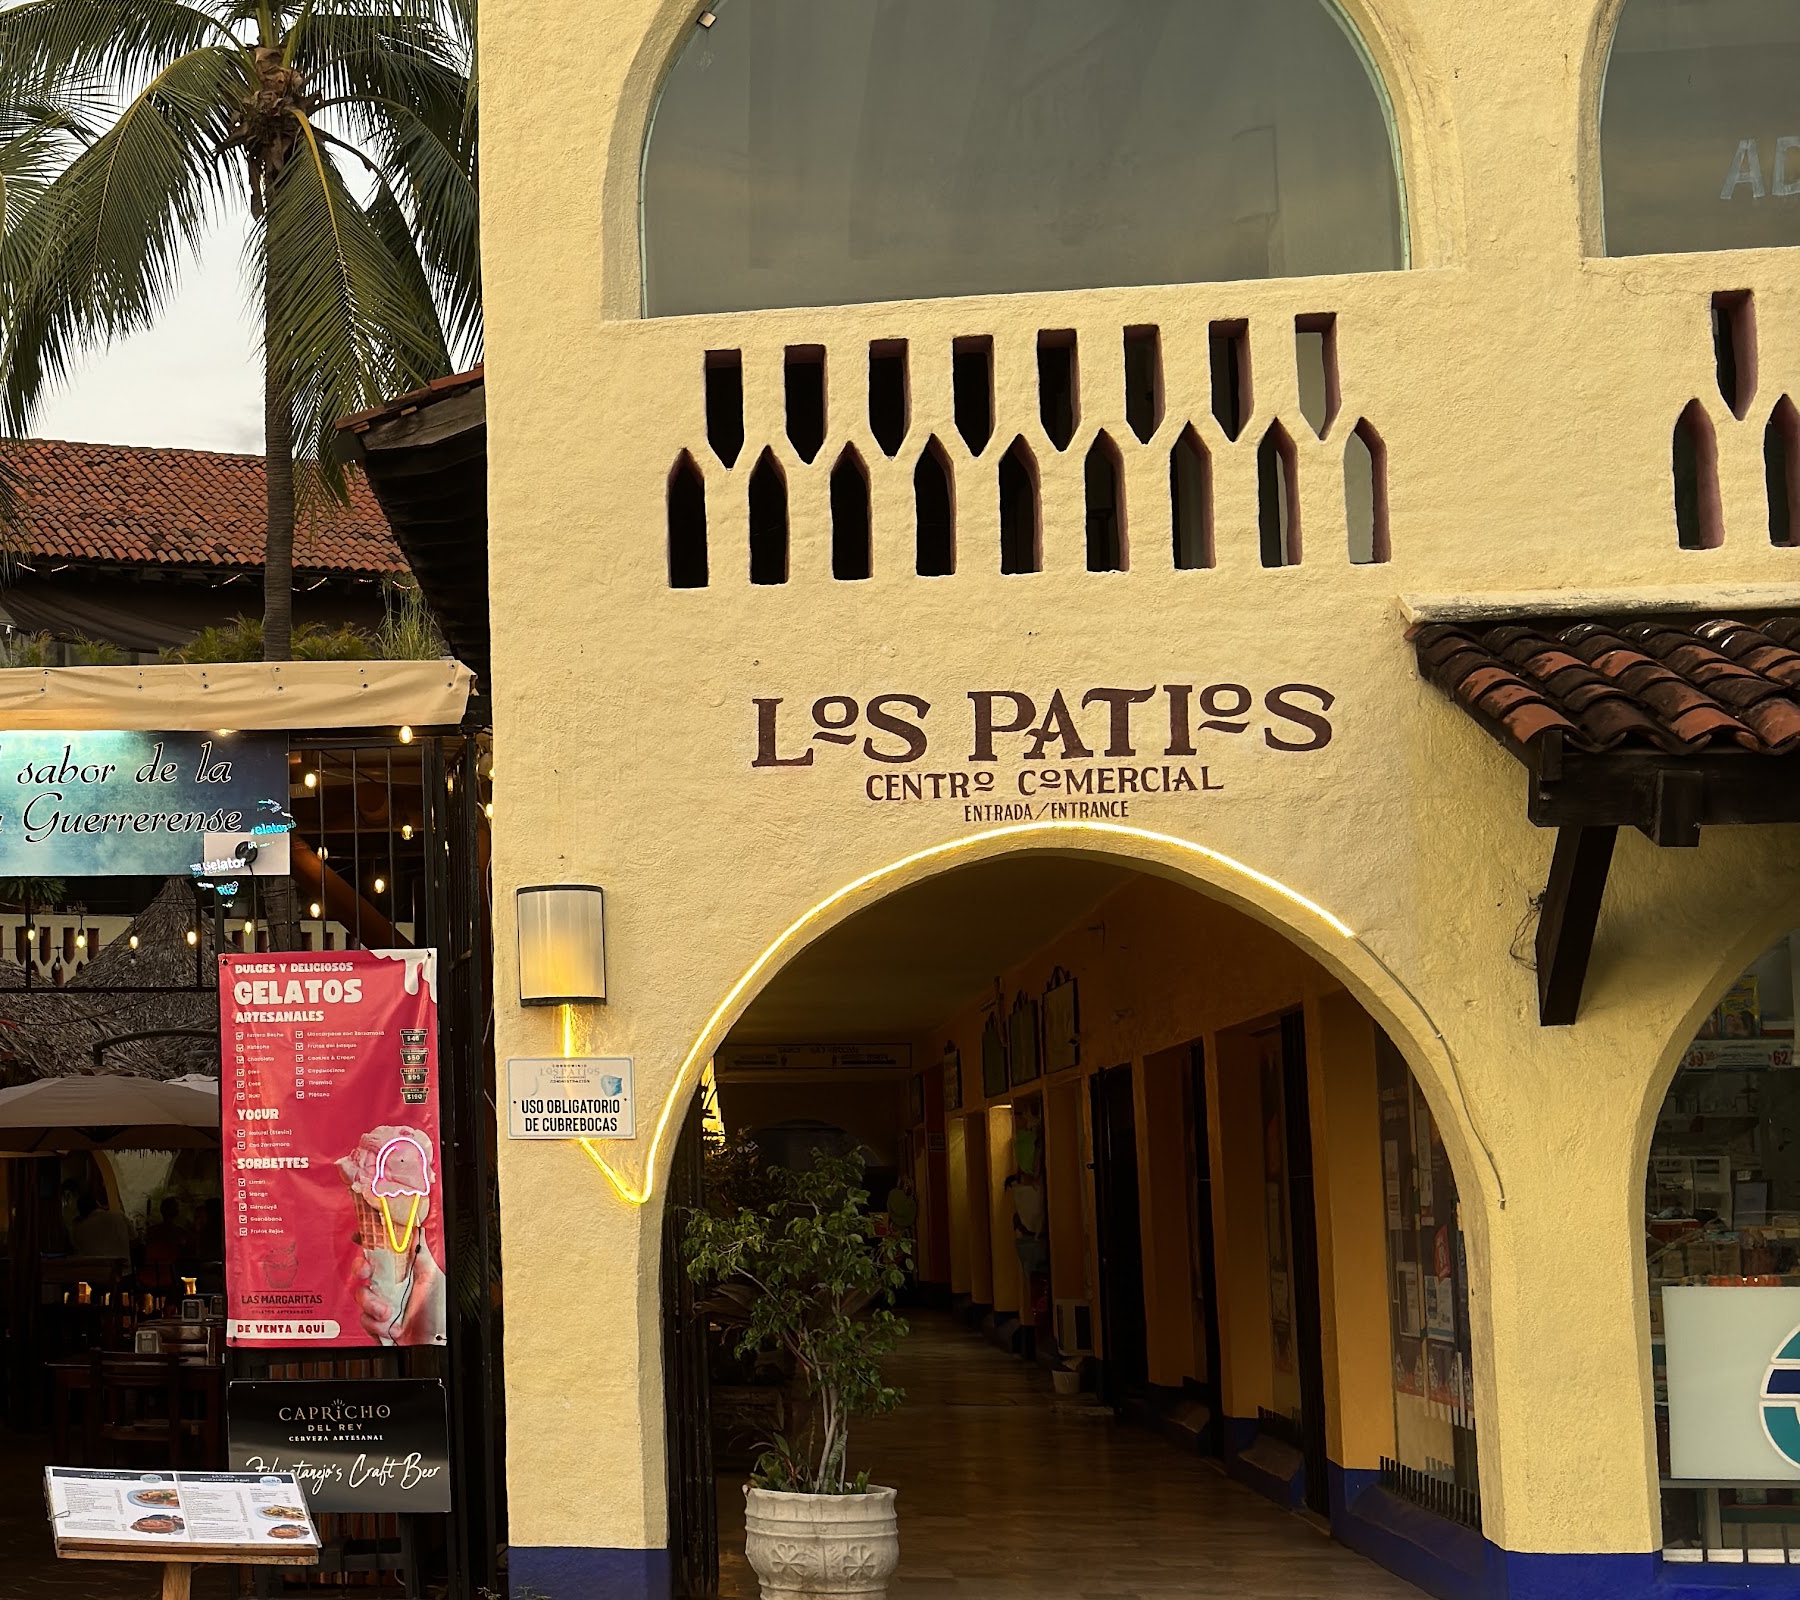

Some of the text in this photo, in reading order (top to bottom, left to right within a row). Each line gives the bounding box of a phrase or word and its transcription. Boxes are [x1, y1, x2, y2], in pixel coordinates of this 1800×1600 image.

[17, 744, 116, 785] sabor
[135, 741, 178, 784] de
[195, 740, 233, 784] la
[865, 766, 1225, 801] CENTRO COMERCIAL
[23, 792, 243, 843] Guerrerense
[235, 962, 353, 974] DULCES Y DELICIOSOS
[234, 979, 363, 1005] GELATOS
[235, 1010, 324, 1023] ARTESANALES
[521, 1099, 620, 1114] USO OBLIGATORIO
[237, 1108, 279, 1120] YOGUR
[525, 1117, 618, 1132] DE CUBREBOCAS
[237, 1156, 309, 1169] SORBETTES
[241, 1295, 323, 1304] LAS MARGARITAS
[237, 1322, 325, 1334] DE VENTA AQUÍ
[308, 1423, 363, 1432] DEL REY
[349, 1453, 399, 1488] Craft
[400, 1452, 441, 1490] Beer
